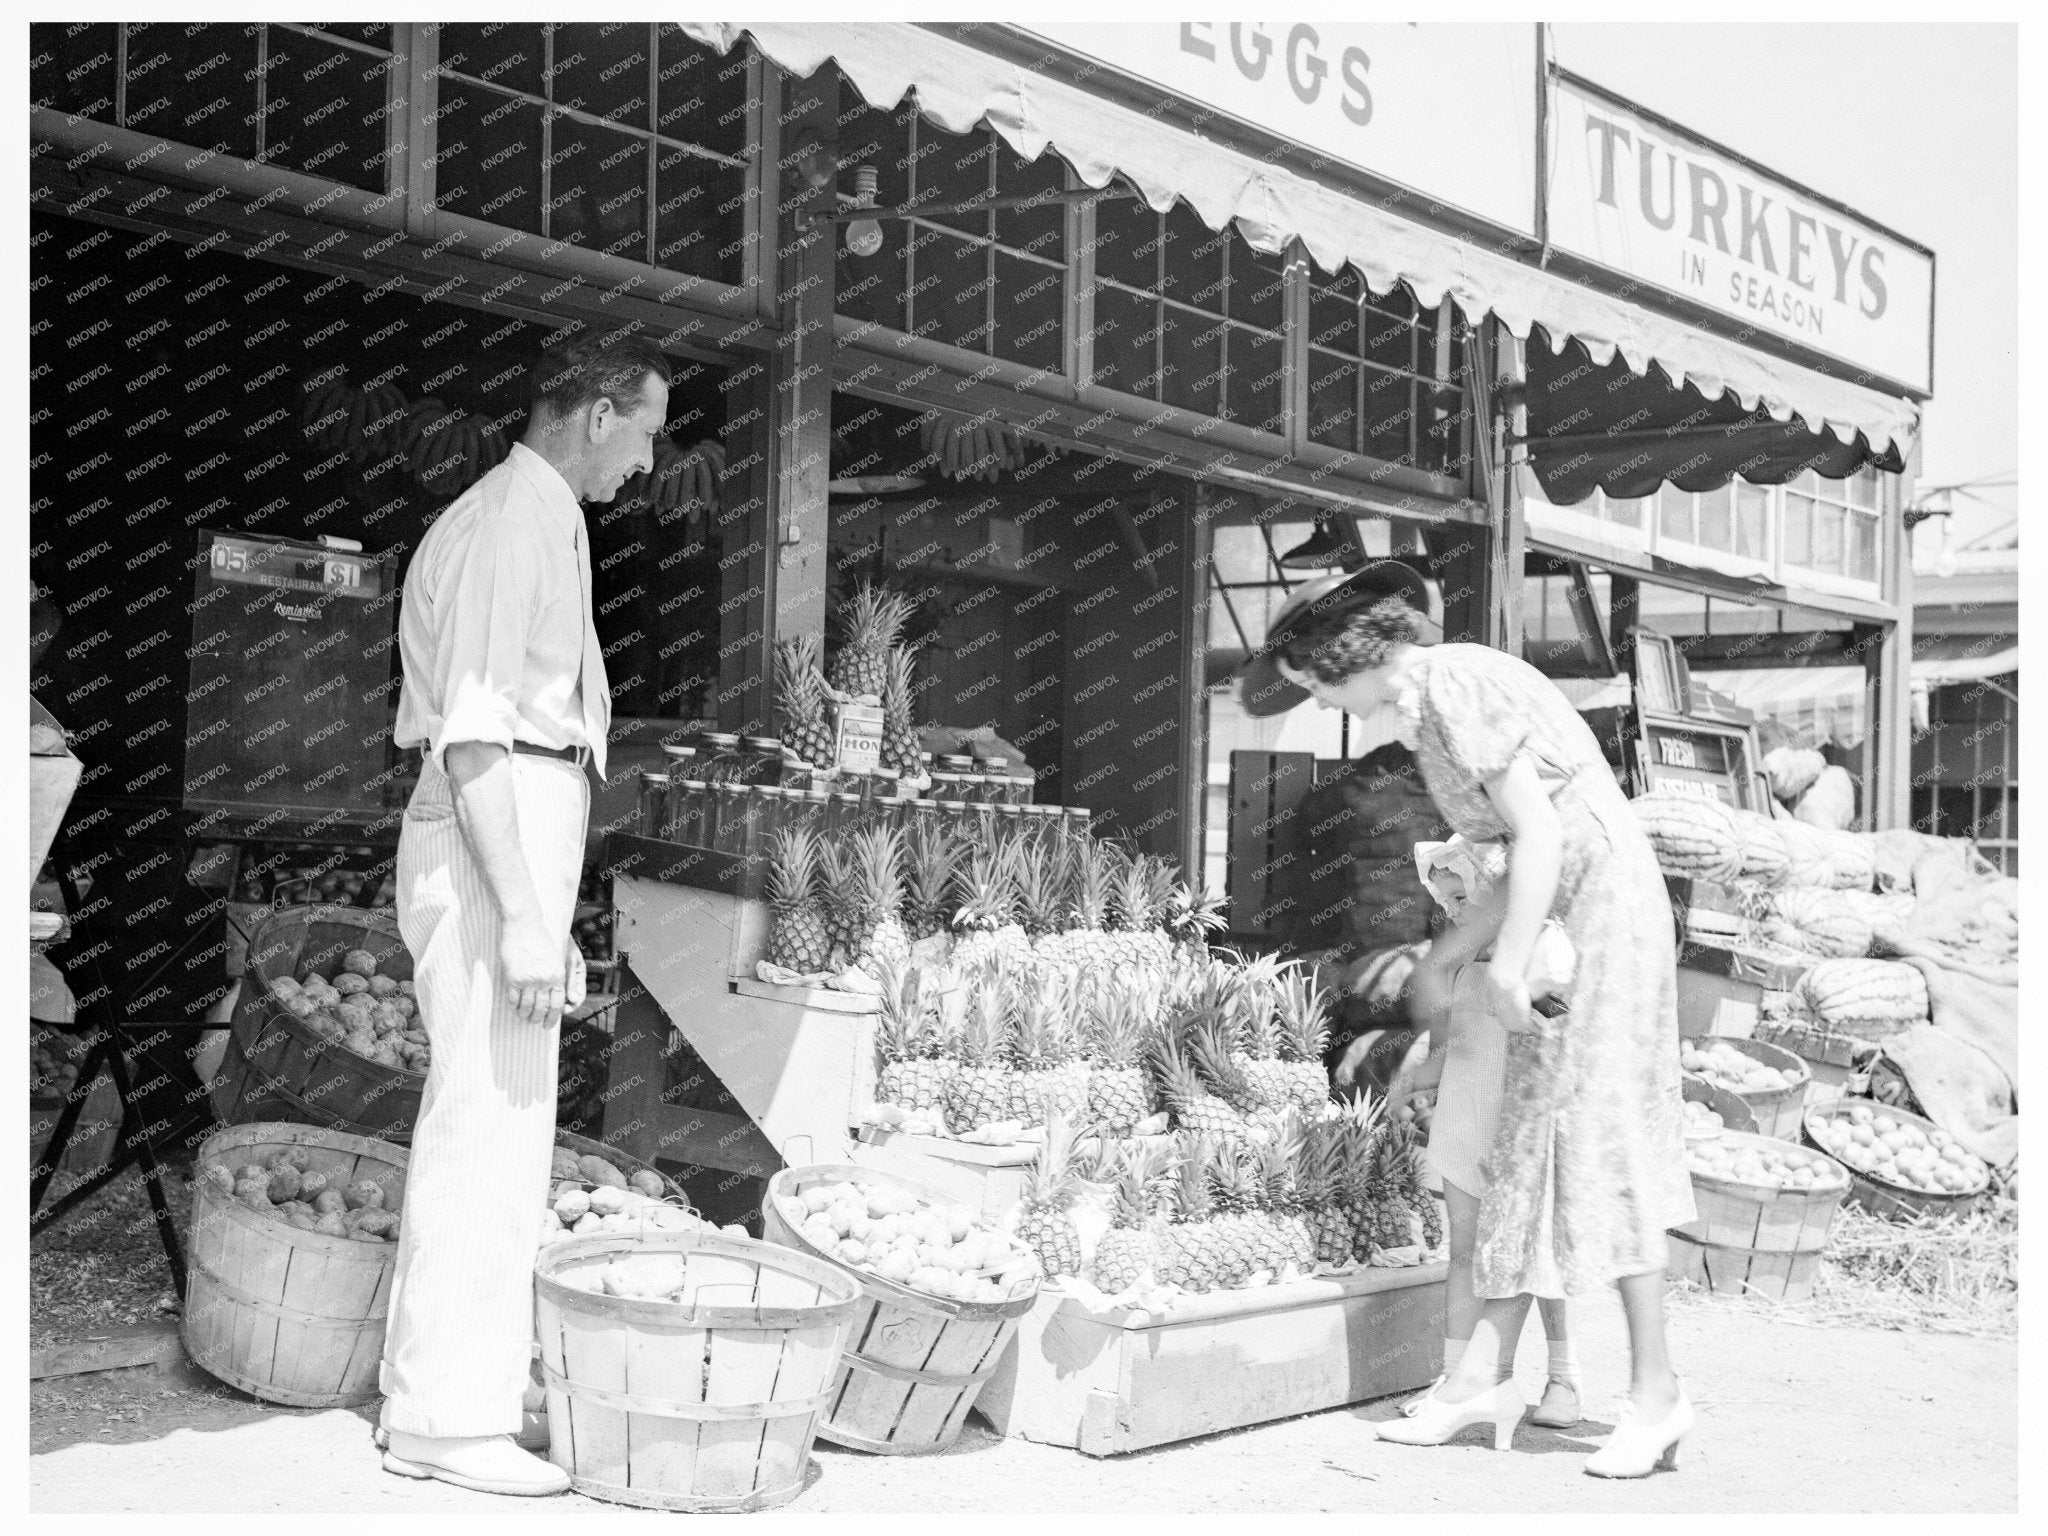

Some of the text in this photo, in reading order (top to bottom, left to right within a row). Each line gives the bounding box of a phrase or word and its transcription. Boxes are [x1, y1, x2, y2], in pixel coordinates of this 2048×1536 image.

[1180, 22, 1373, 126] EGGS
[1586, 114, 1887, 320] TURKEYS
[1682, 250, 1823, 334] IN SEASON
